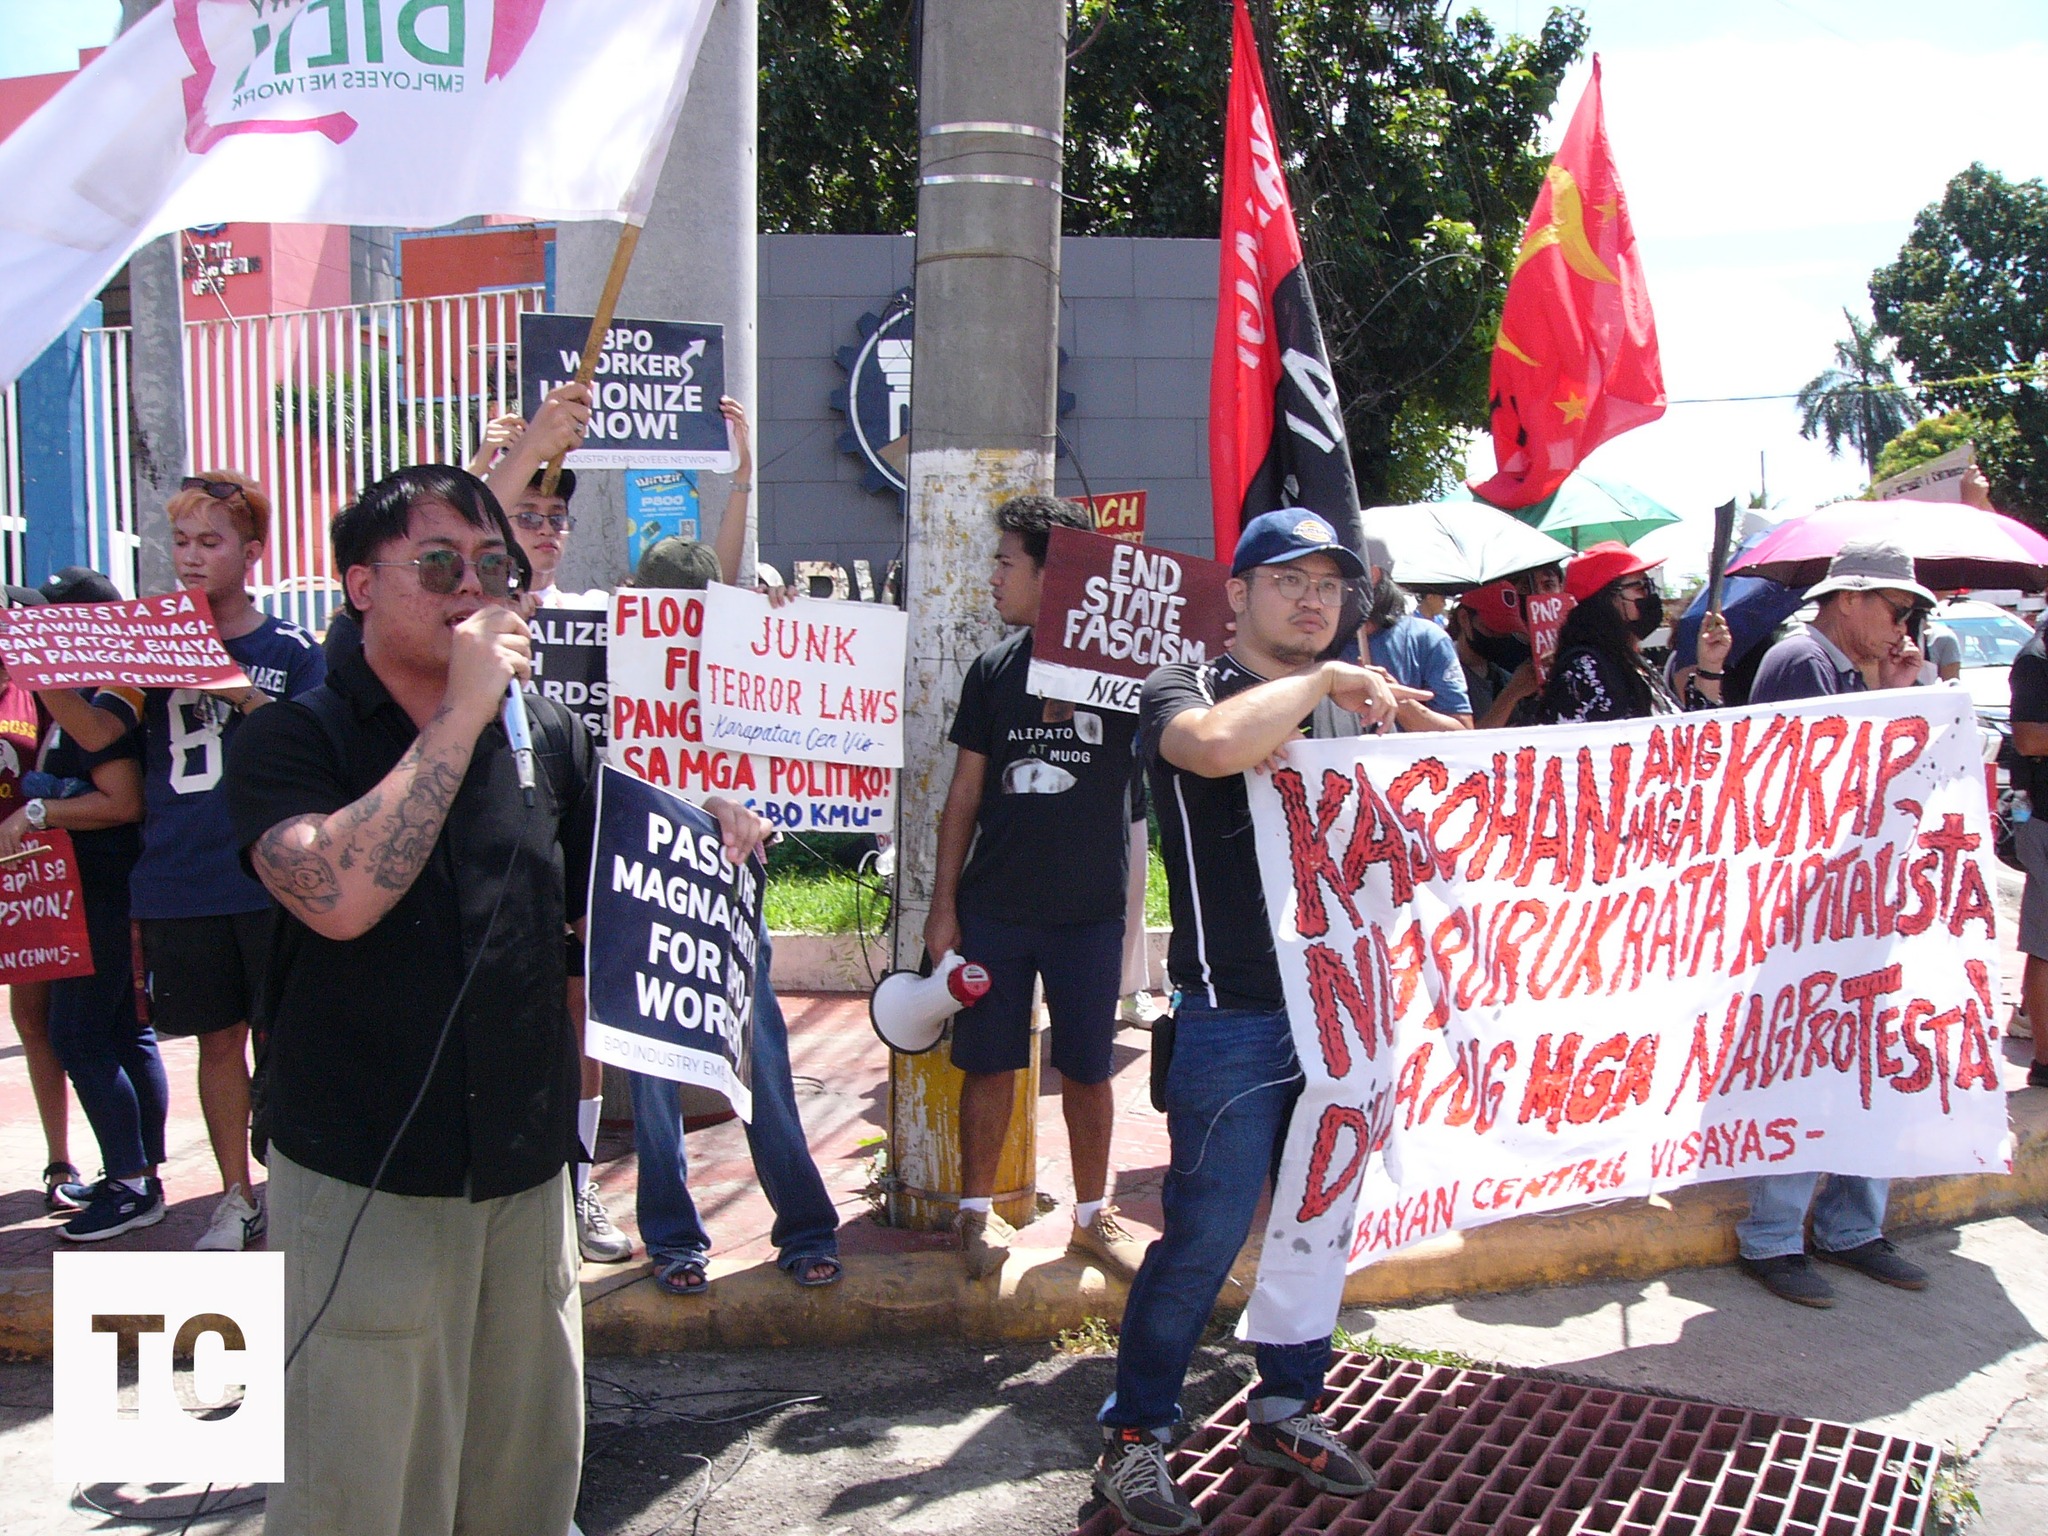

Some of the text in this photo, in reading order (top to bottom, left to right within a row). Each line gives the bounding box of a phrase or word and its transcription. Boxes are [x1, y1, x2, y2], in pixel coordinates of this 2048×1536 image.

[583, 411, 678, 440] NOW!
[1111, 544, 1182, 595] END
[161, 595, 196, 616] SA
[616, 595, 704, 638] FLOO
[1082, 576, 1187, 633] STATE
[1530, 597, 1562, 624] PNP
[53, 636, 136, 650] BATOK
[529, 620, 608, 646] ALIZE
[751, 616, 858, 666] JUNK
[1063, 609, 1206, 667] FASCISM
[5, 652, 42, 665] SA
[707, 663, 802, 715] TERROR
[819, 683, 899, 724] LAWS
[1007, 727, 1074, 741] ALIPATO
[1027, 744, 1048, 755] AT
[1049, 750, 1092, 763] MUOG
[624, 746, 891, 802] SA MGA POLITIKO!
[1635, 719, 1723, 797] ANG
[648, 812, 735, 884] PASS
[1616, 784, 1704, 878] MGA
[0, 889, 74, 926] PSYON!
[612, 854, 732, 932] MAGNA
[648, 921, 722, 985] FOR
[633, 1043, 700, 1073] INDUSTRY
[1347, 1180, 1460, 1263] BAYAN
